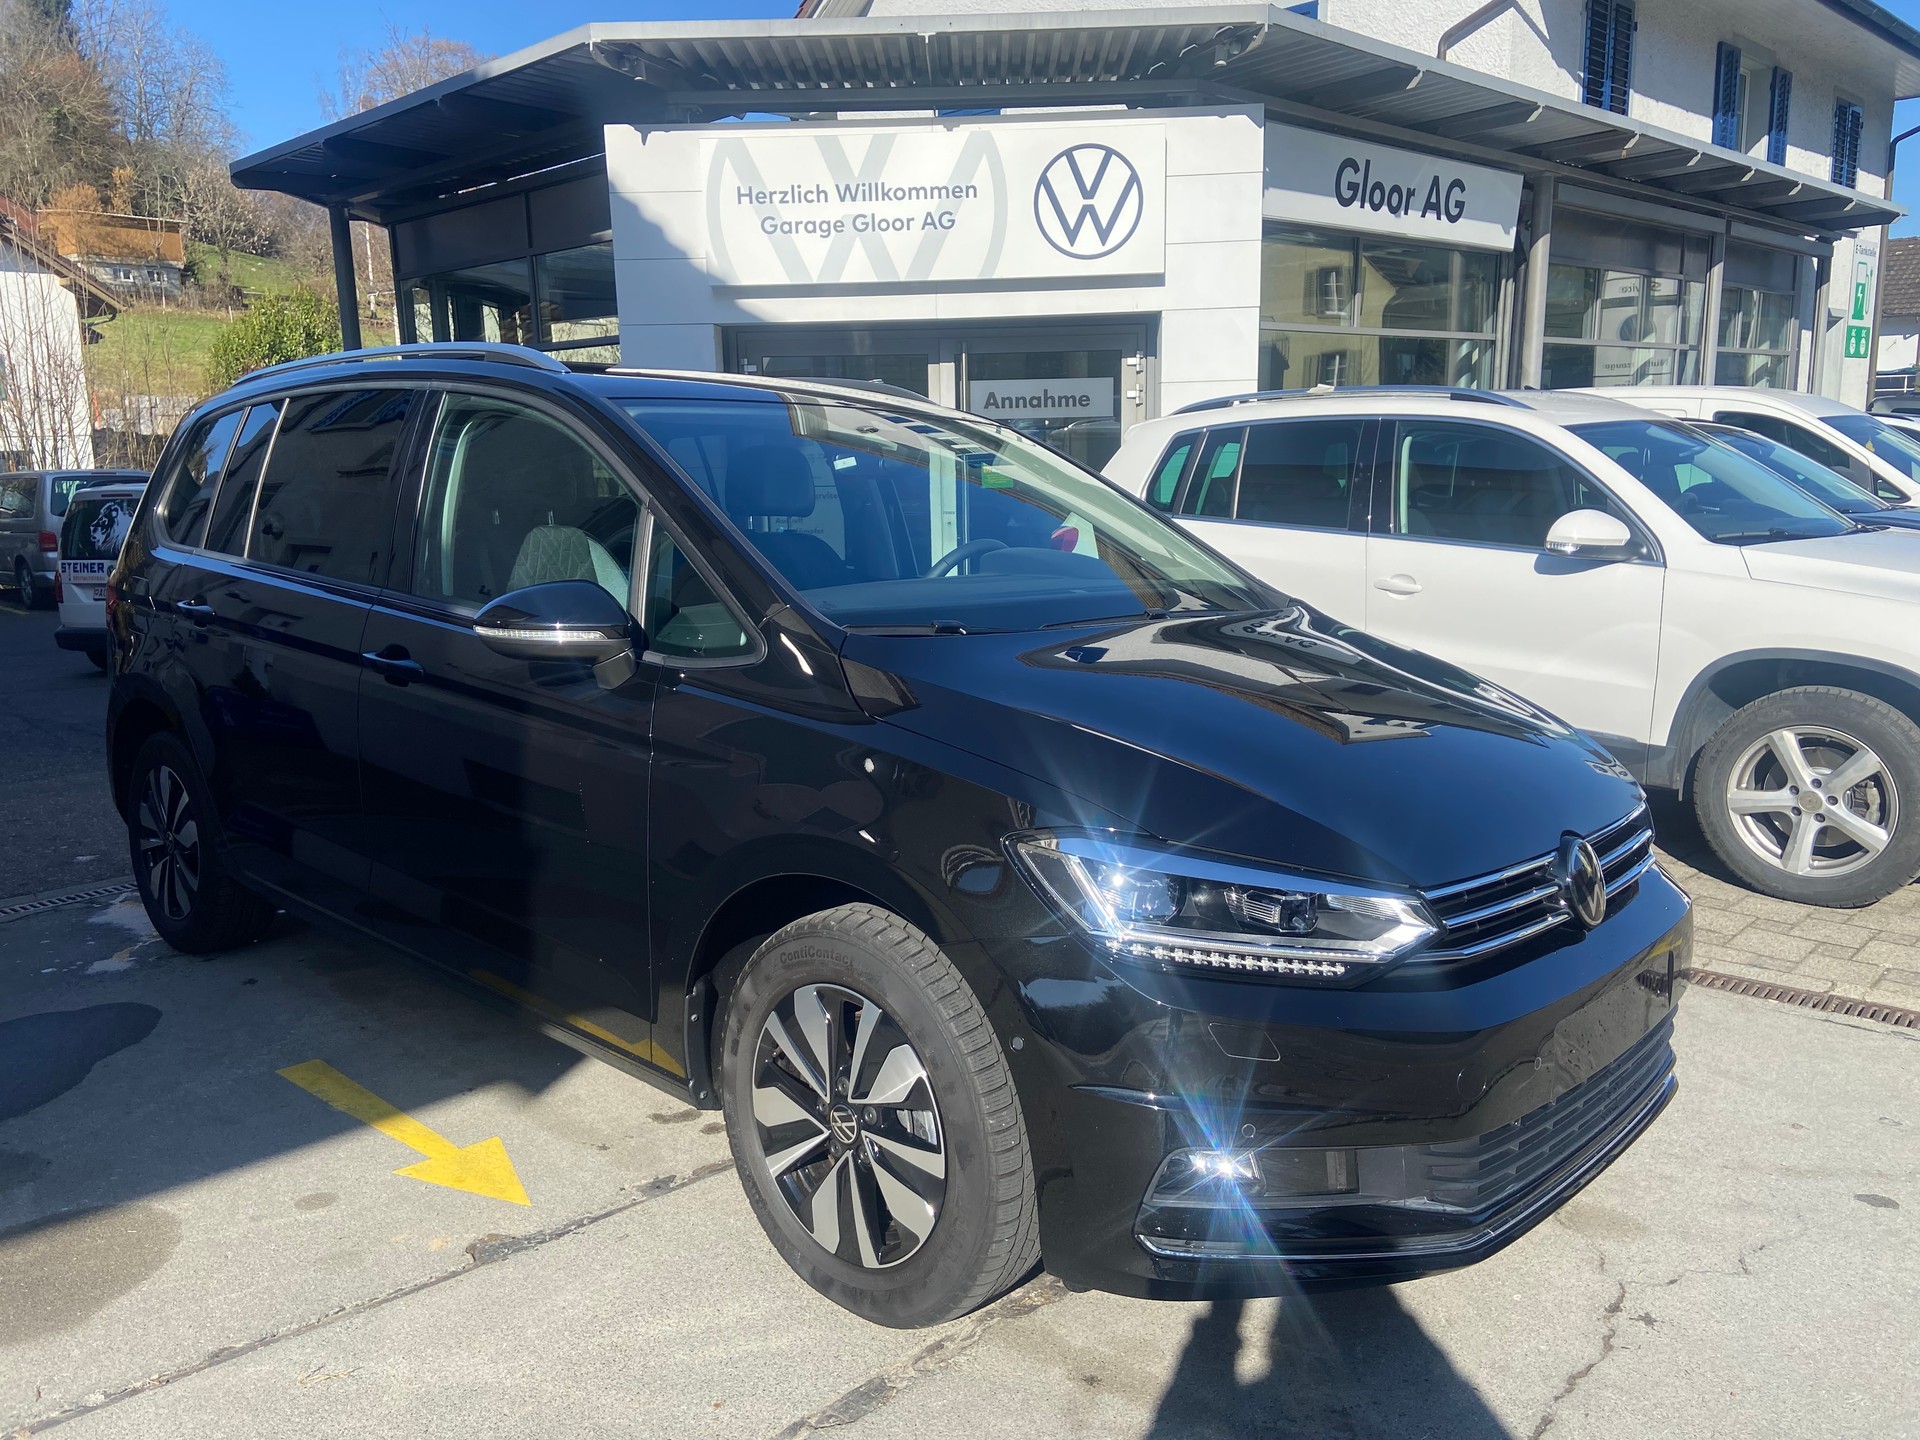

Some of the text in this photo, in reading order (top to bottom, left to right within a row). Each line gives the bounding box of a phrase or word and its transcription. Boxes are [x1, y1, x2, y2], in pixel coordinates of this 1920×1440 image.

[737, 182, 978, 205] Herzlich Willkommen
[1334, 157, 1466, 223] Gloor AG
[760, 210, 956, 239] Garage Gloor AG
[984, 388, 1091, 411] Annahme
[61, 562, 105, 574] STEINER
